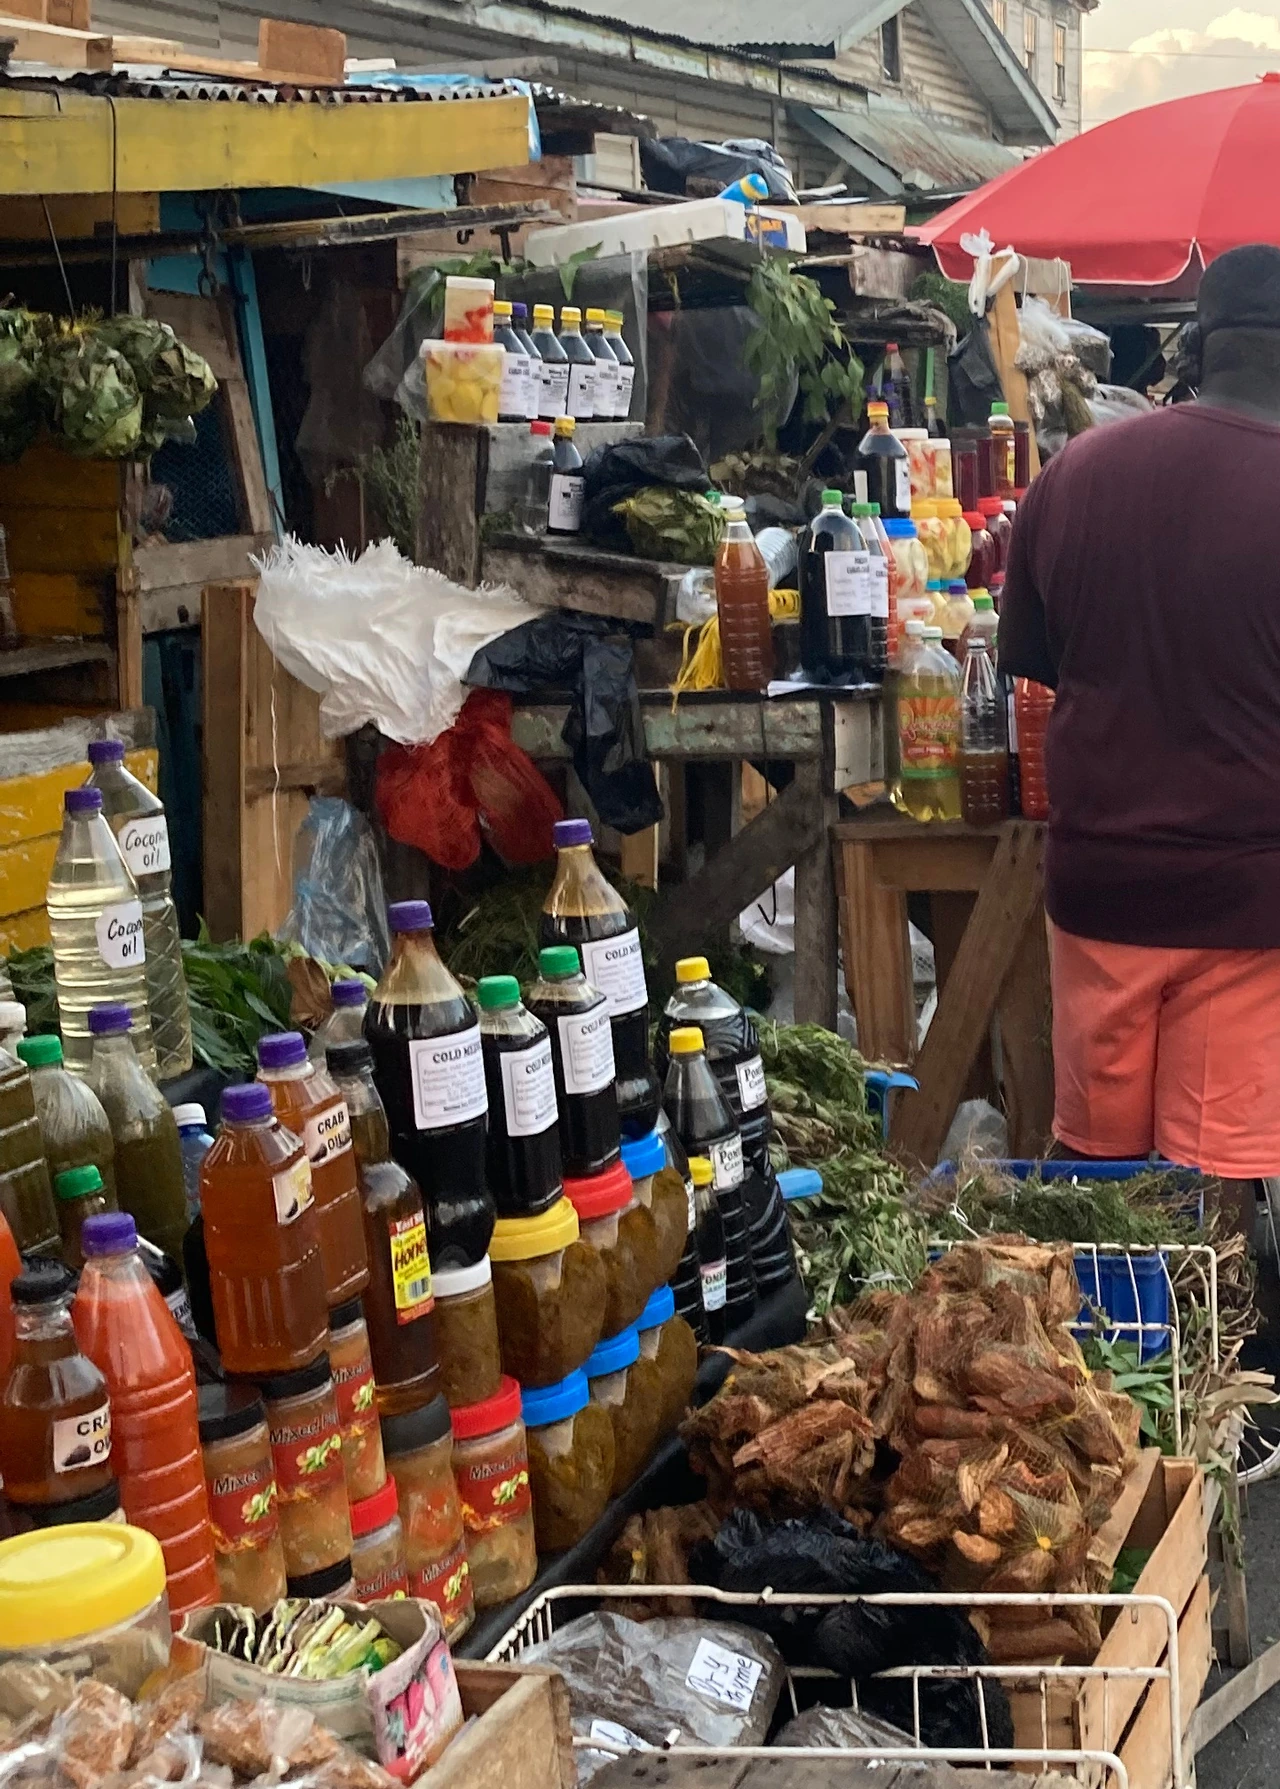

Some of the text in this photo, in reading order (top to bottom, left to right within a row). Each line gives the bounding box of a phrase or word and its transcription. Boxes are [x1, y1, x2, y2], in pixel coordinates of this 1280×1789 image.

[122, 935, 137, 957] oil
[604, 946, 629, 961] COLD
[432, 1047, 462, 1064] COLD
[317, 1110, 345, 1135] CRAB
[327, 1133, 345, 1151] OIL
[270, 1416, 321, 1445] Mixed
[470, 1456, 515, 1481] Mixed
